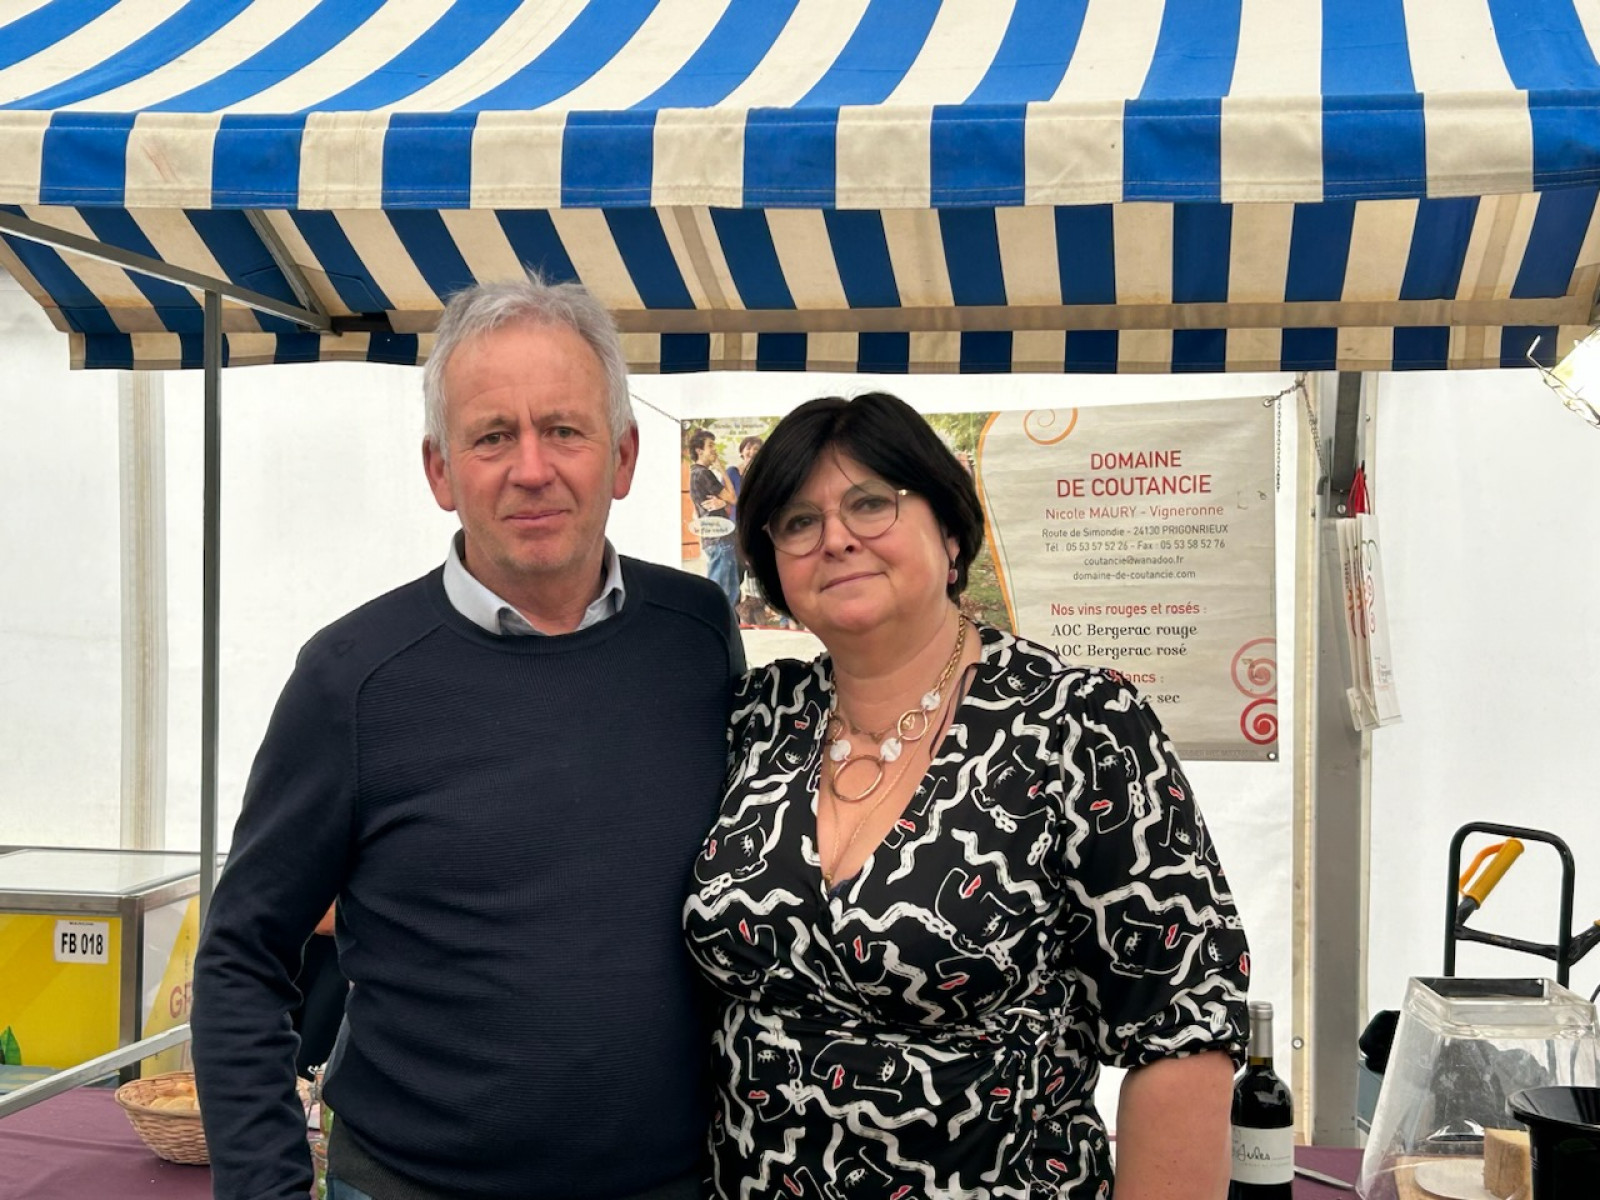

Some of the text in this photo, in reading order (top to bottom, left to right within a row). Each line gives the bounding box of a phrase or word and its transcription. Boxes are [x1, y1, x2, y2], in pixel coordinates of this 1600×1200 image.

[1090, 450, 1182, 470] DOMAINE
[1057, 474, 1212, 498] DE COUTANCIE
[1045, 507, 1085, 521] Nicole
[1089, 505, 1137, 519] MAURY
[1149, 505, 1224, 520] Vigneronne
[1041, 528, 1068, 538] Route
[1069, 527, 1080, 537] de
[1083, 527, 1125, 537] Simondie
[1133, 525, 1160, 535] 24130
[1162, 524, 1229, 535] PRIGONRIEUX
[1066, 541, 1077, 552] 05
[1079, 541, 1090, 551] 53
[1092, 541, 1102, 551] 57
[1105, 540, 1116, 551] 52
[1117, 540, 1128, 550] 26
[1137, 540, 1153, 550] Fax
[1160, 540, 1172, 549] 05
[1174, 539, 1185, 549] 53
[1187, 539, 1198, 549] 58
[1200, 539, 1211, 549] 52
[1214, 538, 1225, 548] 76
[1084, 555, 1184, 566] coutancie@wanadoo.fr
[1073, 570, 1196, 581] domaine-de-coutancie.com
[1051, 603, 1075, 615] Nos
[1078, 603, 1102, 615] vins
[1105, 604, 1147, 618] rouges
[1150, 603, 1162, 614] et
[1165, 601, 1200, 614] rosés
[1051, 623, 1198, 640] AOC Bergerac rouge
[1053, 643, 1187, 660] AOC Bergerac rosé
[1156, 694, 1180, 703] sec
[61, 932, 104, 955] FB 018
